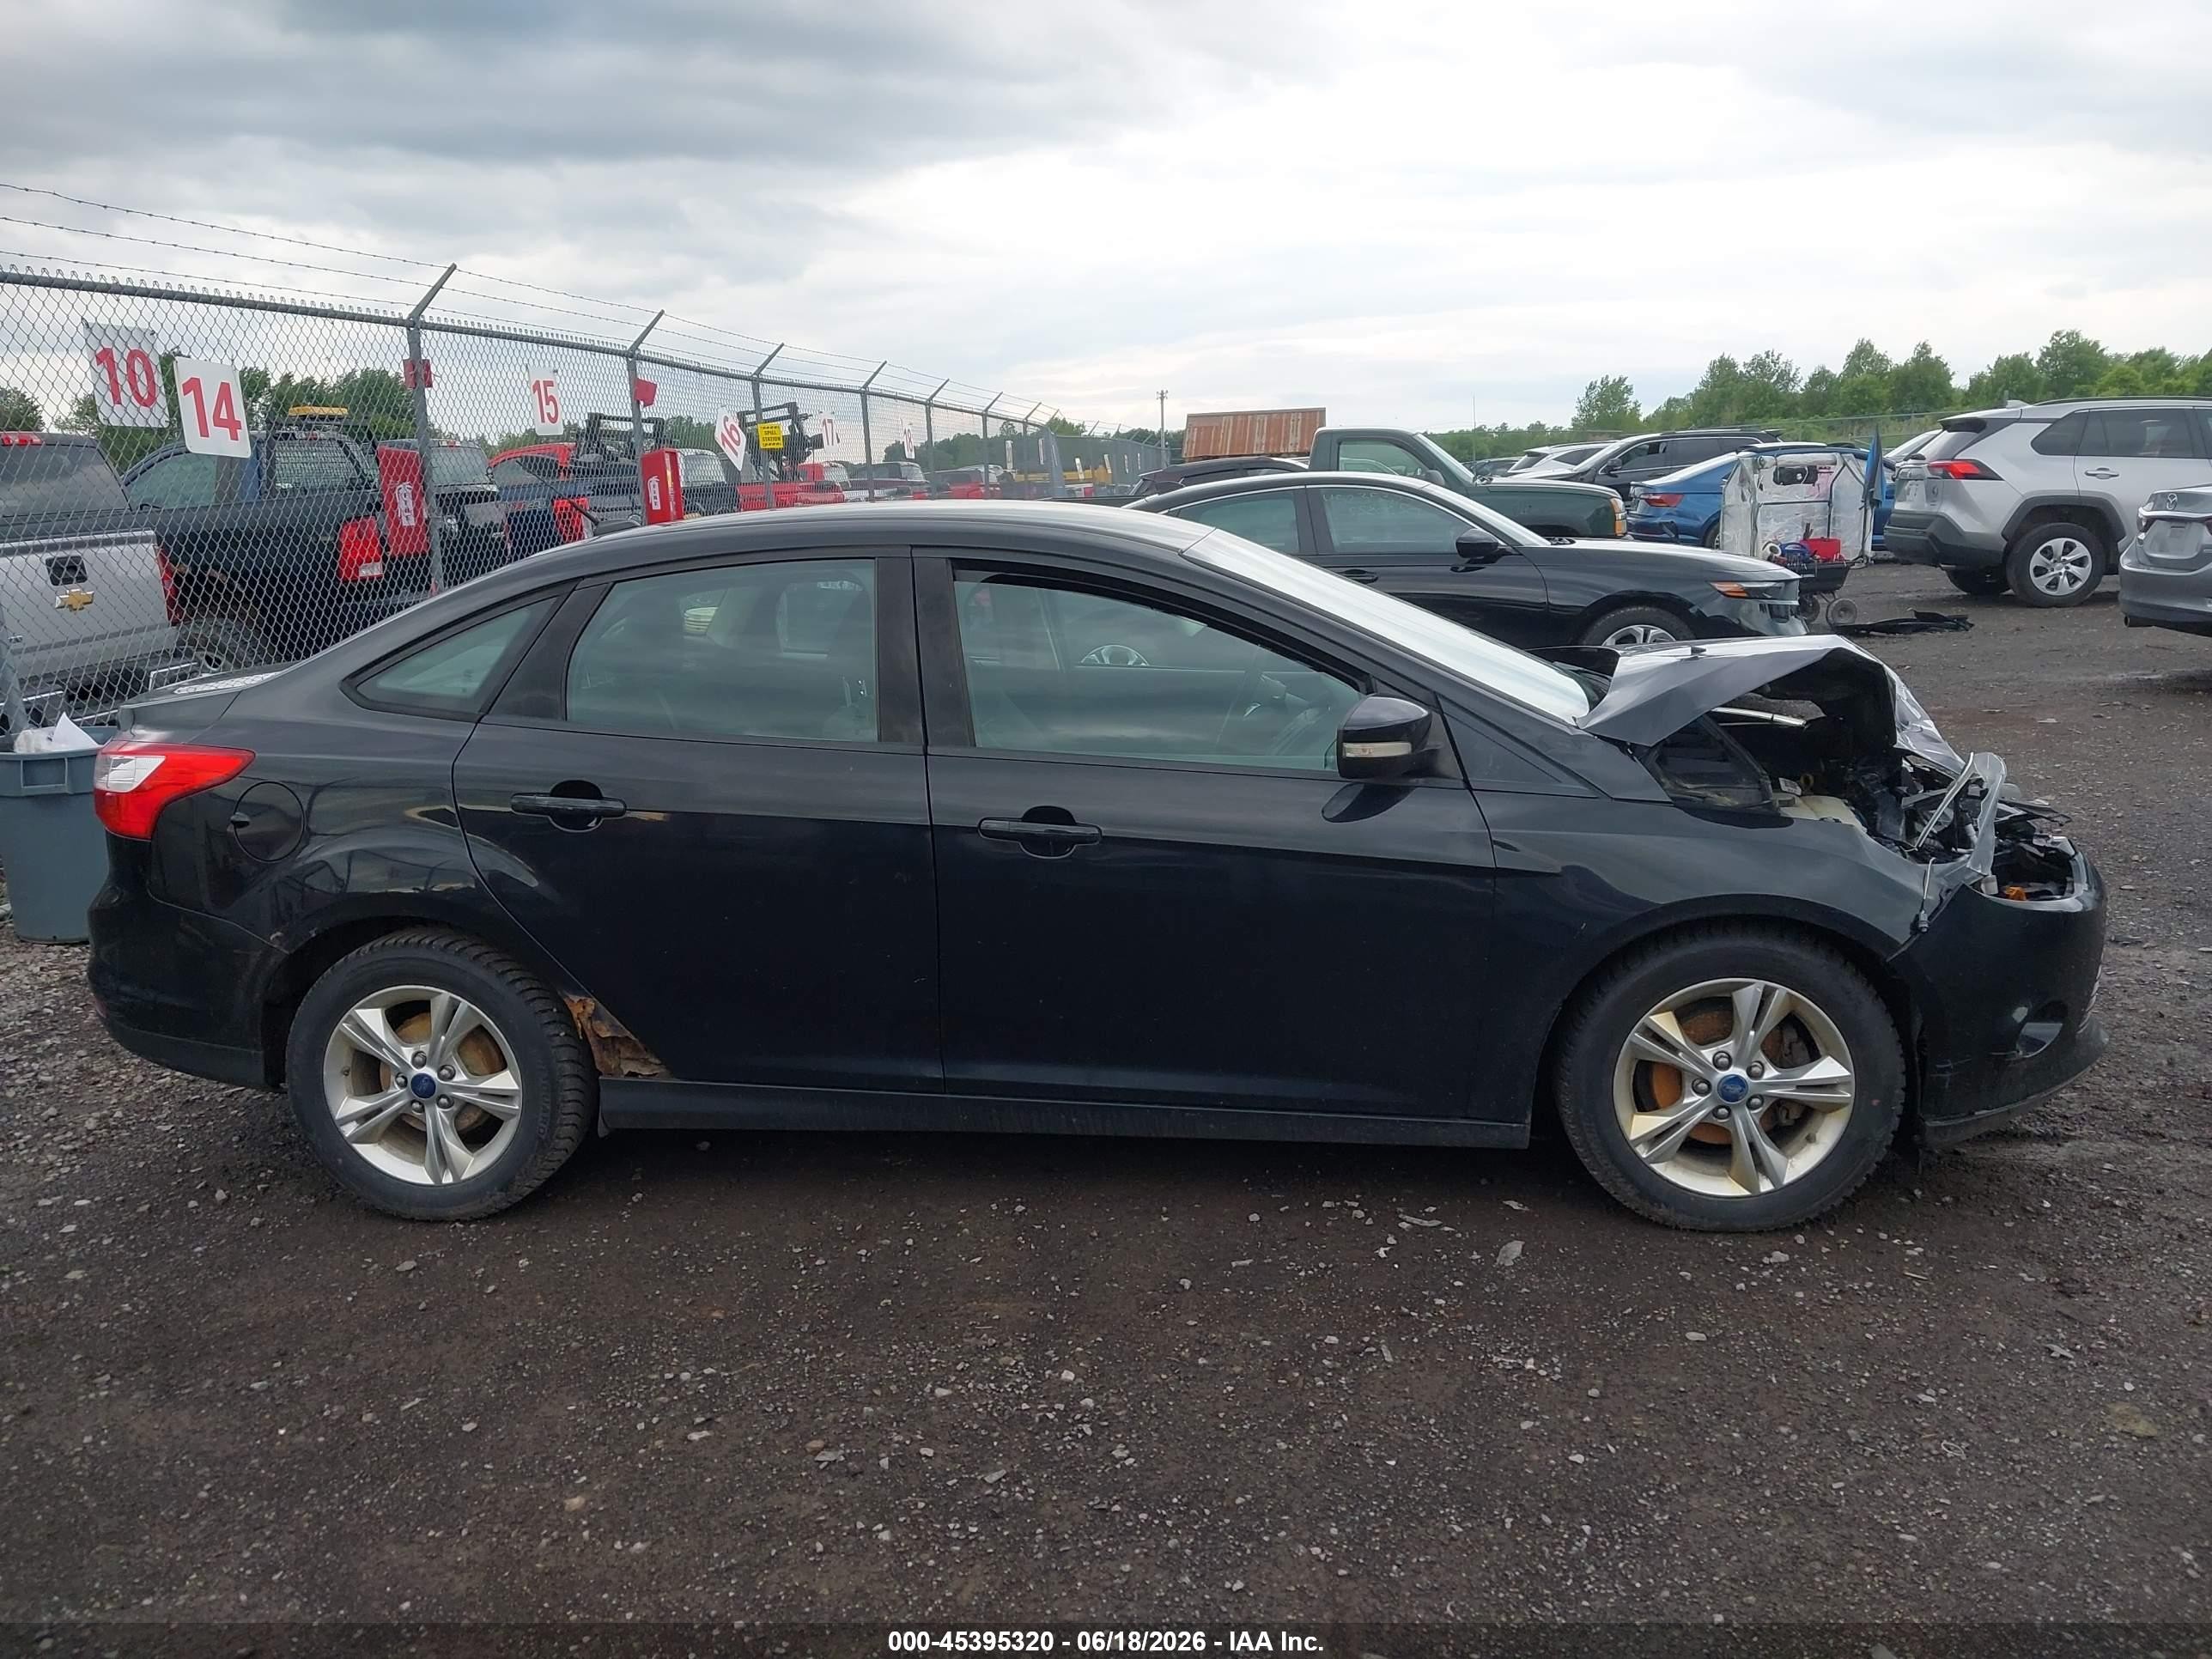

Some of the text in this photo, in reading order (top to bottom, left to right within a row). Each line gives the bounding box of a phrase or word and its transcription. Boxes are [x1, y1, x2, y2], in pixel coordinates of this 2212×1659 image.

[96, 347, 156, 408] 10
[182, 377, 242, 441] 14
[532, 380, 558, 424] 15
[721, 415, 741, 459] 16
[822, 418, 834, 446] 17
[903, 428, 913, 453] 18
